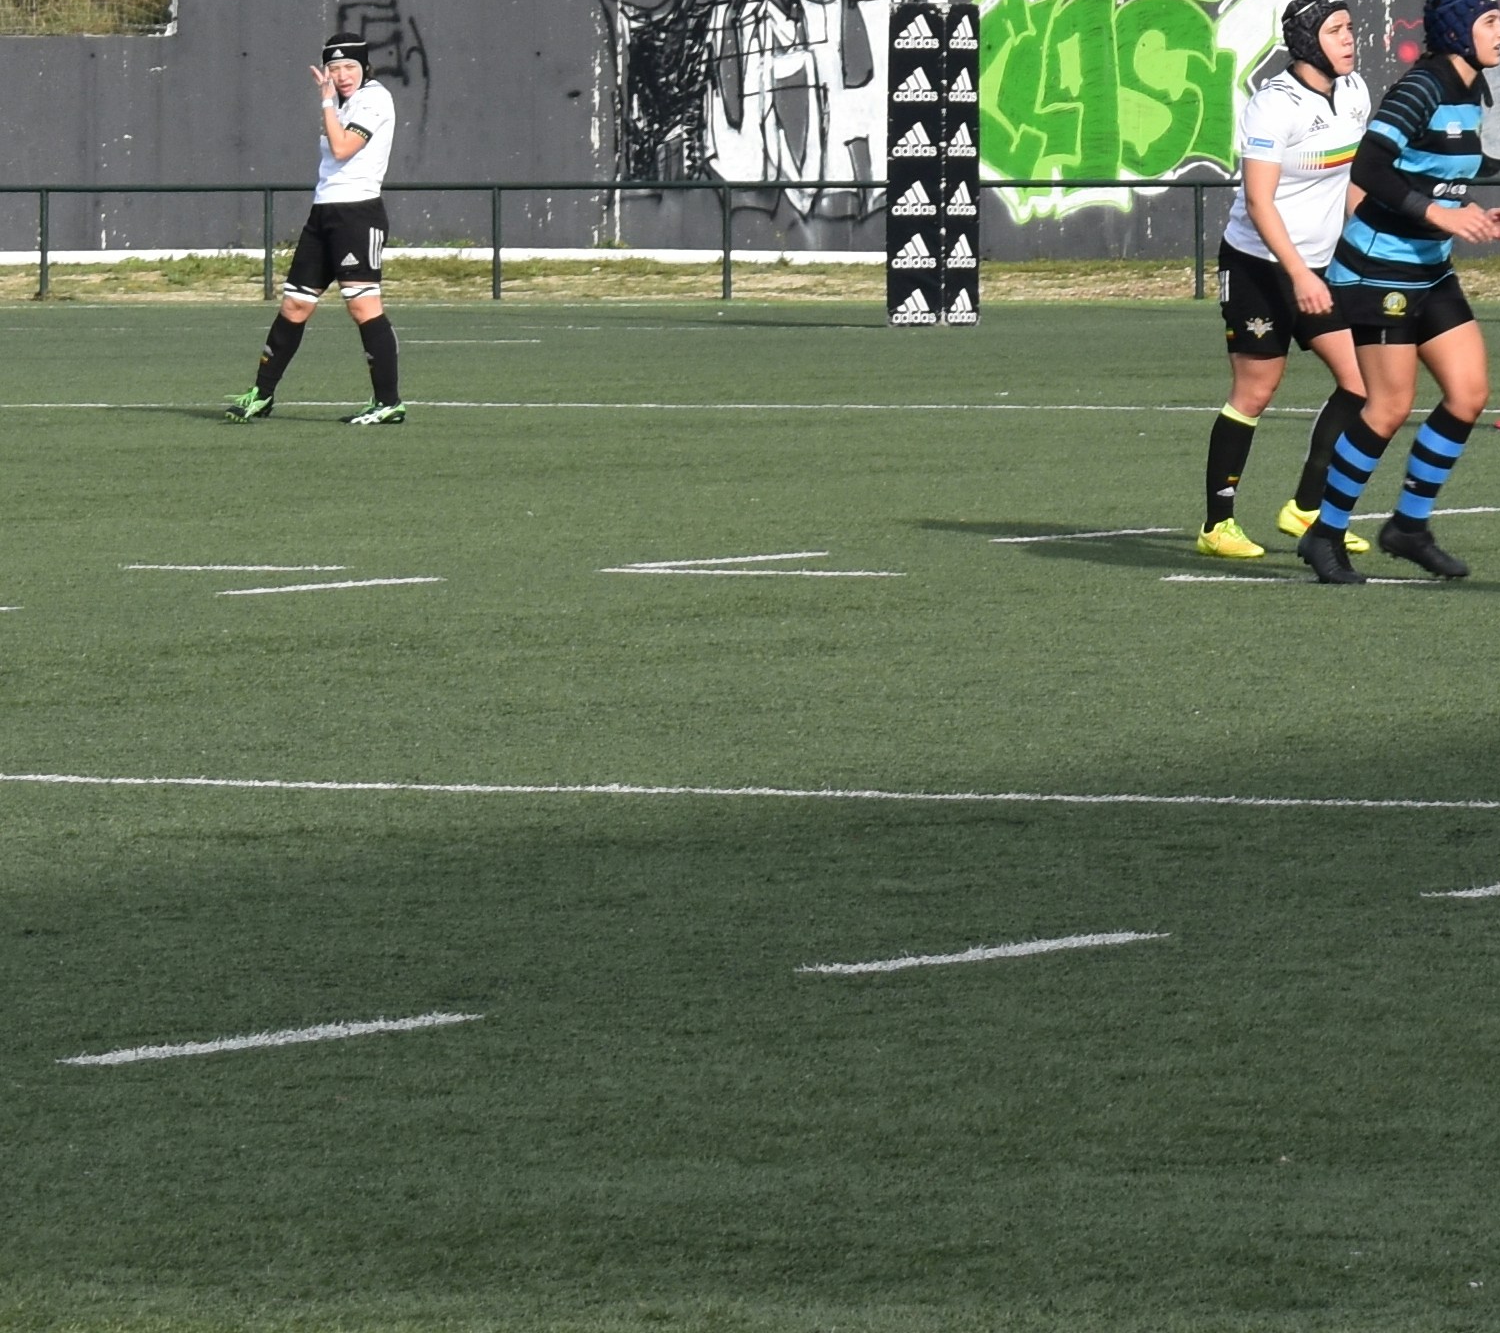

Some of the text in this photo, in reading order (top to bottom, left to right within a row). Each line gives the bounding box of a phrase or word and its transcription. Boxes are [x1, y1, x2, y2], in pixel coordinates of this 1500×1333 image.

[894, 38, 940, 49] adidas
[893, 90, 939, 102] adidas
[892, 145, 937, 157] adidas
[891, 204, 936, 216] adidas
[891, 257, 936, 269] adidas
[892, 312, 936, 324] adidas
